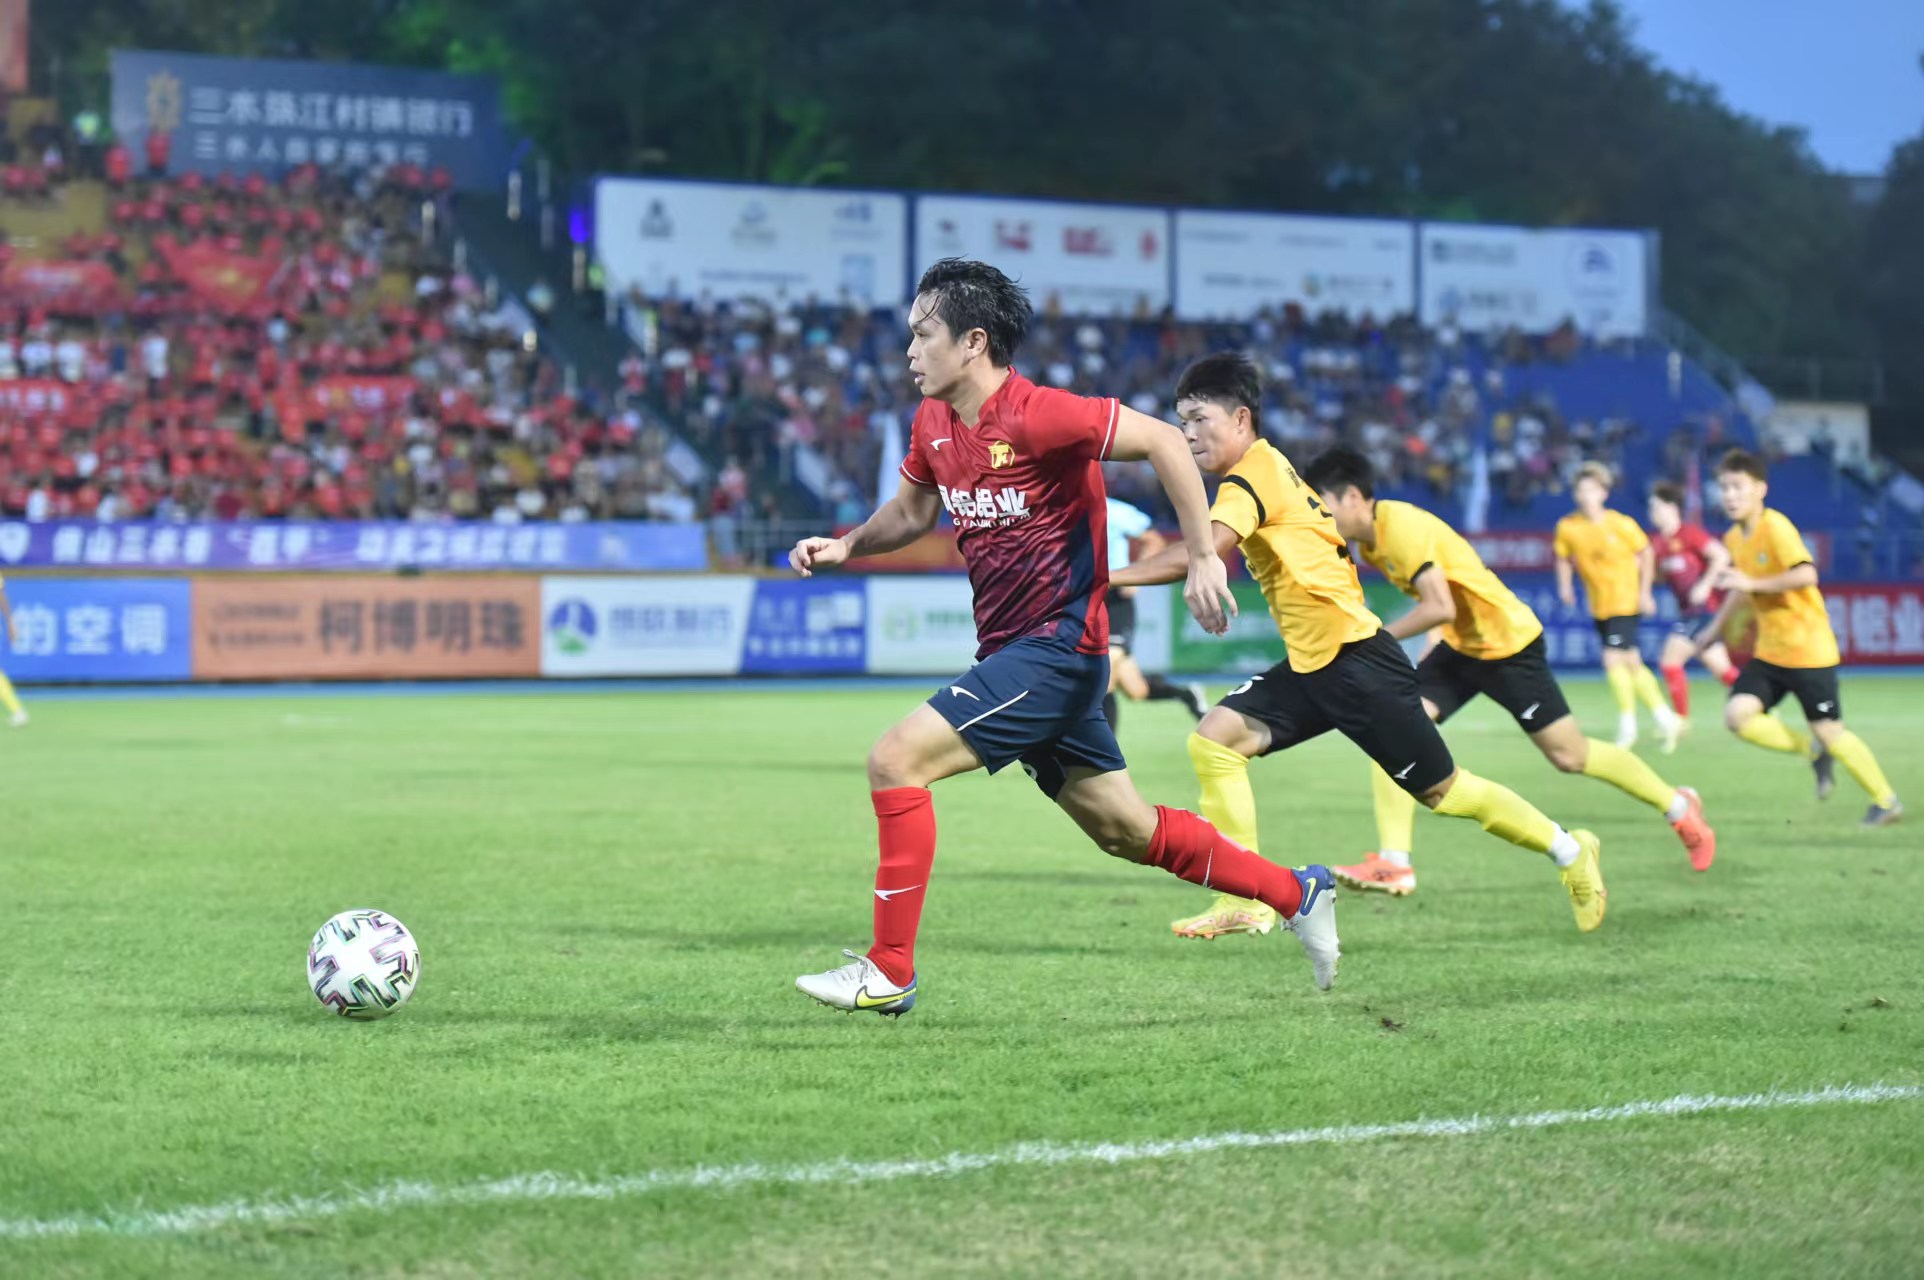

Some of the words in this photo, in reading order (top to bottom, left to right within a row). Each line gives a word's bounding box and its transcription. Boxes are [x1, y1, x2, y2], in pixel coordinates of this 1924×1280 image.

[11, 603, 168, 656] 的空调
[320, 599, 525, 655] 柯博明珠
